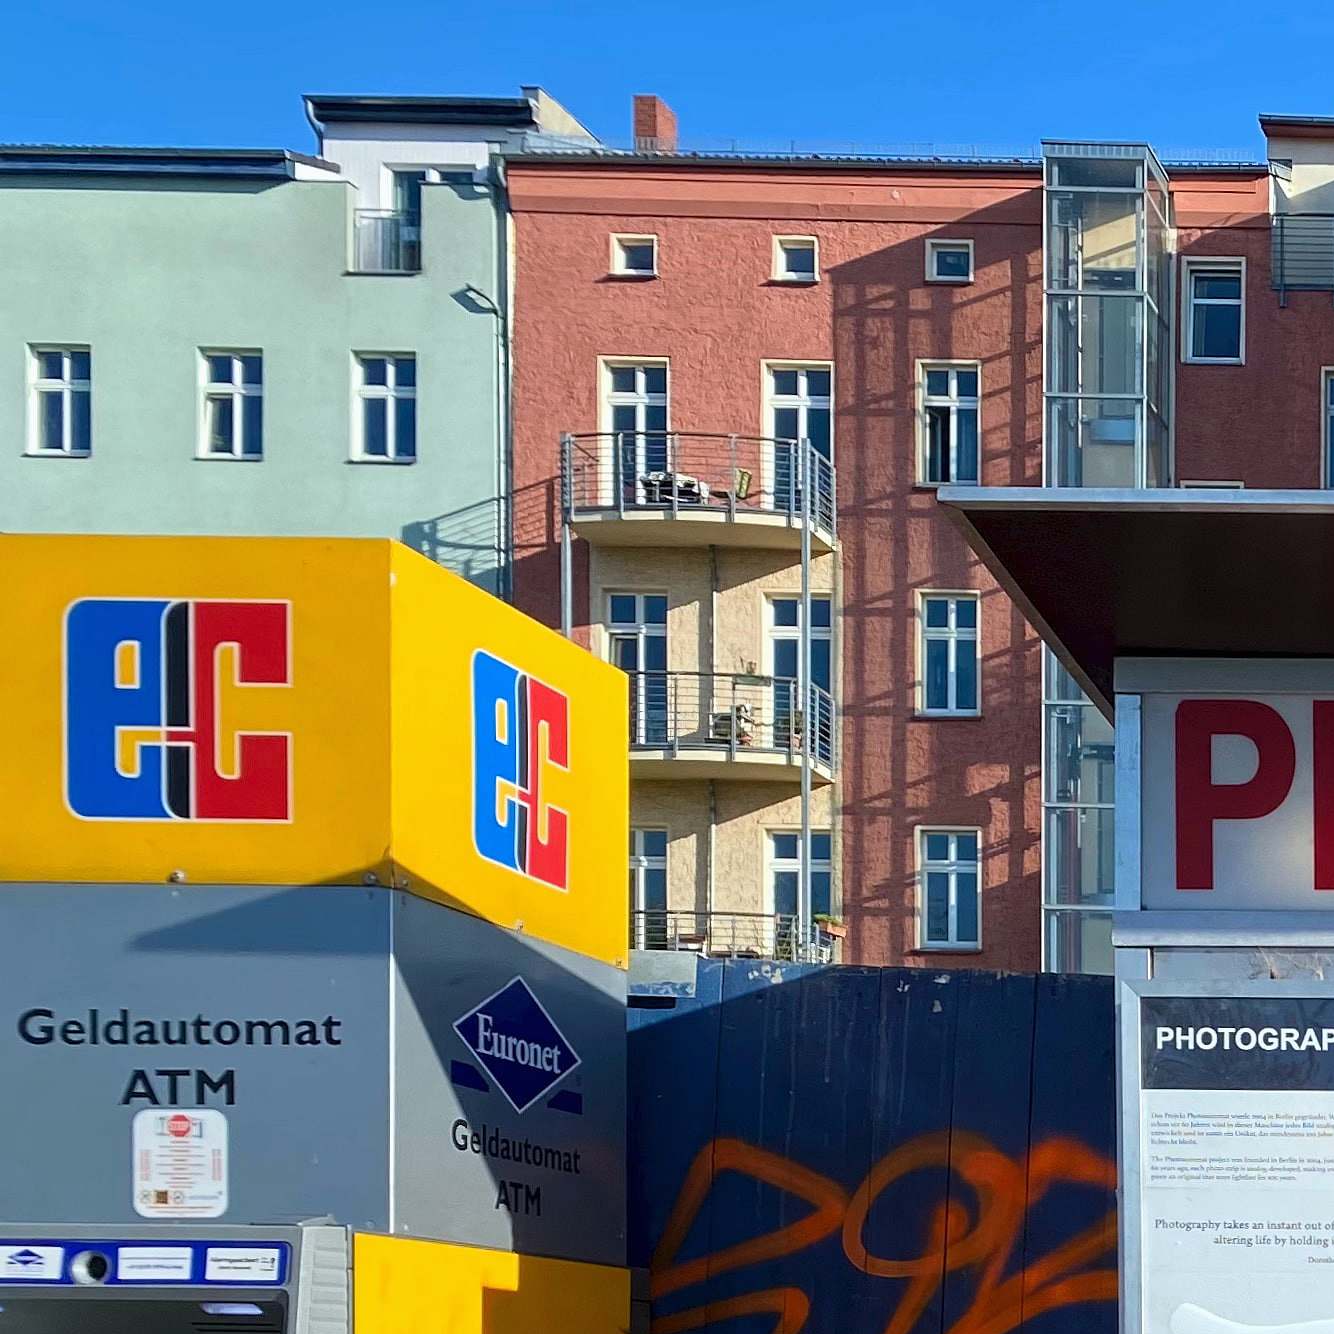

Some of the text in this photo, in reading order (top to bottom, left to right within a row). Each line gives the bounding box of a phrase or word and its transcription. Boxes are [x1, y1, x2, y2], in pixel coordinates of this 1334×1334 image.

[17, 1008, 342, 1045] Geldautomat
[475, 1012, 561, 1074] Euronet
[119, 1069, 235, 1105] ATM
[452, 1120, 580, 1174] Geldautomat
[496, 1180, 541, 1216] ATM
[1155, 1219, 1220, 1231] Photography
[1223, 1220, 1249, 1229] takes
[1252, 1222, 1264, 1230] an
[1267, 1221, 1302, 1230] instant
[1305, 1222, 1322, 1231] out
[1213, 1235, 1253, 1247] altering
[1255, 1235, 1271, 1245] life
[1274, 1235, 1287, 1247] by
[1290, 1235, 1329, 1248] holding
